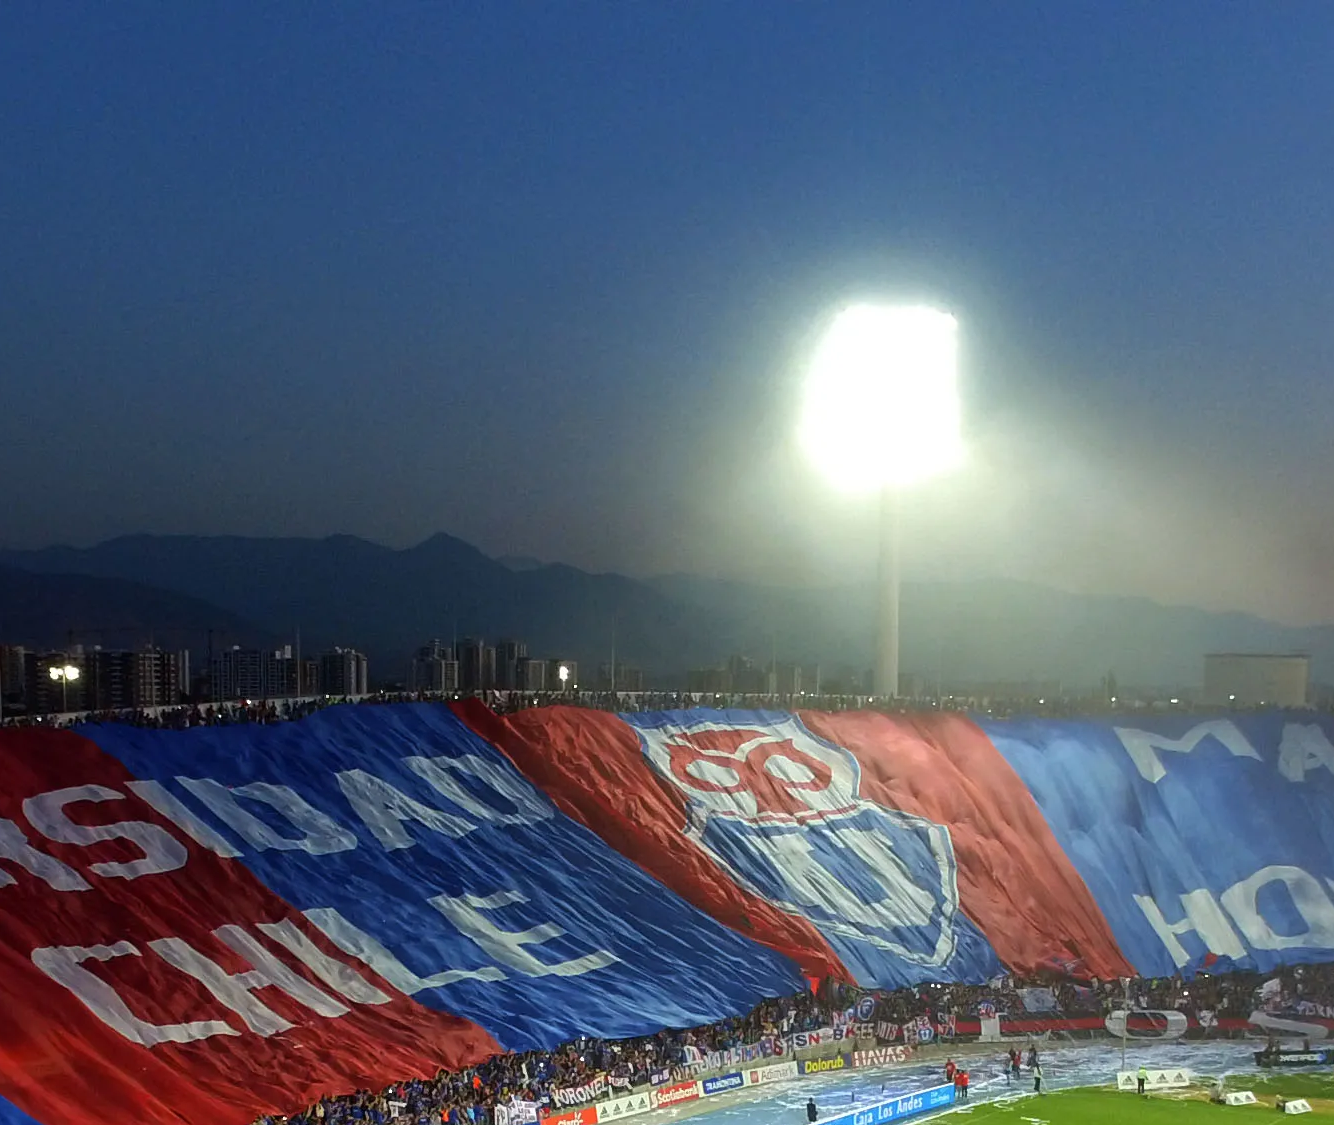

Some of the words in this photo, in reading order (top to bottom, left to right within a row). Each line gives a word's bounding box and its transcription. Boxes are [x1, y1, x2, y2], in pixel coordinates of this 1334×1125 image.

[745, 828, 938, 927] U
[31, 890, 621, 1047] CHILE
[805, 1056, 844, 1073] Dolorub
[854, 1046, 906, 1067] HAVAS
[878, 1104, 893, 1120] Los
[897, 1094, 923, 1113] Andes
